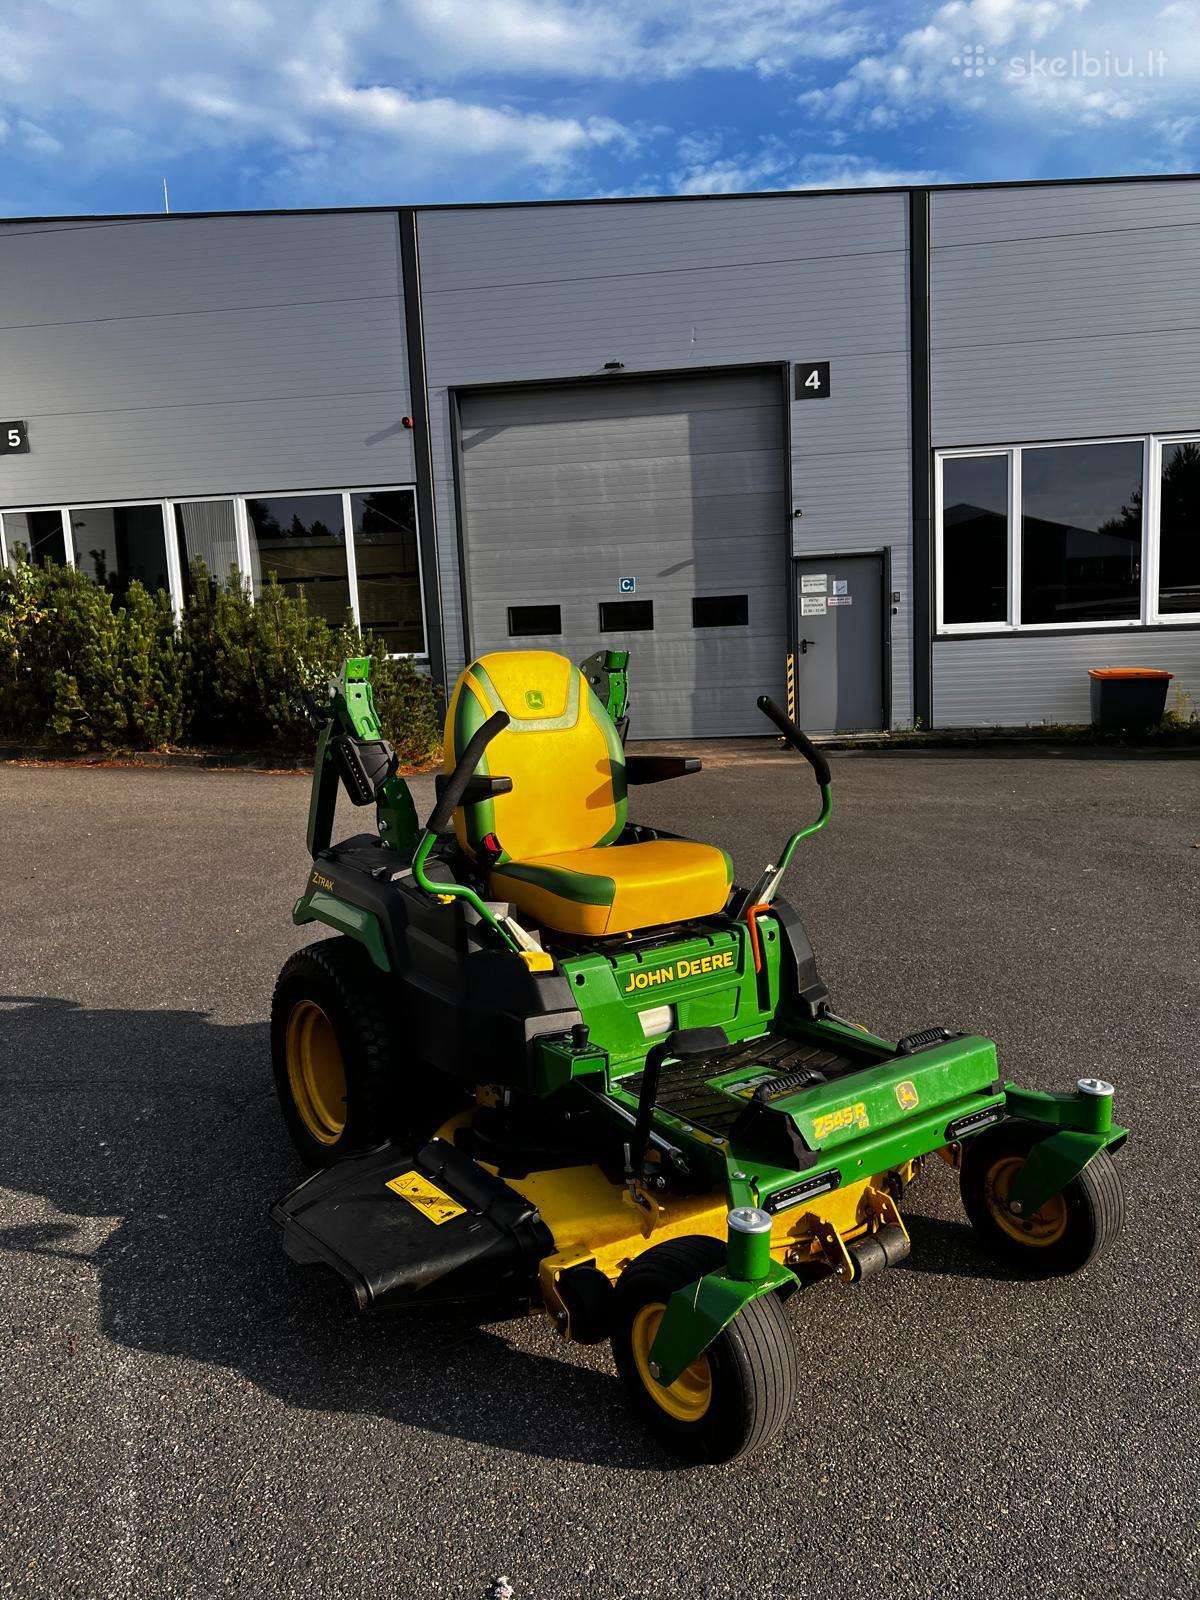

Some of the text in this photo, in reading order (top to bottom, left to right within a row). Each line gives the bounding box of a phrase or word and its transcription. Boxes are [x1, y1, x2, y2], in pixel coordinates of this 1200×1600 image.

[805, 370, 820, 390] 4
[8, 429, 21, 447] 5
[625, 951, 734, 992] JOHN DEERE
